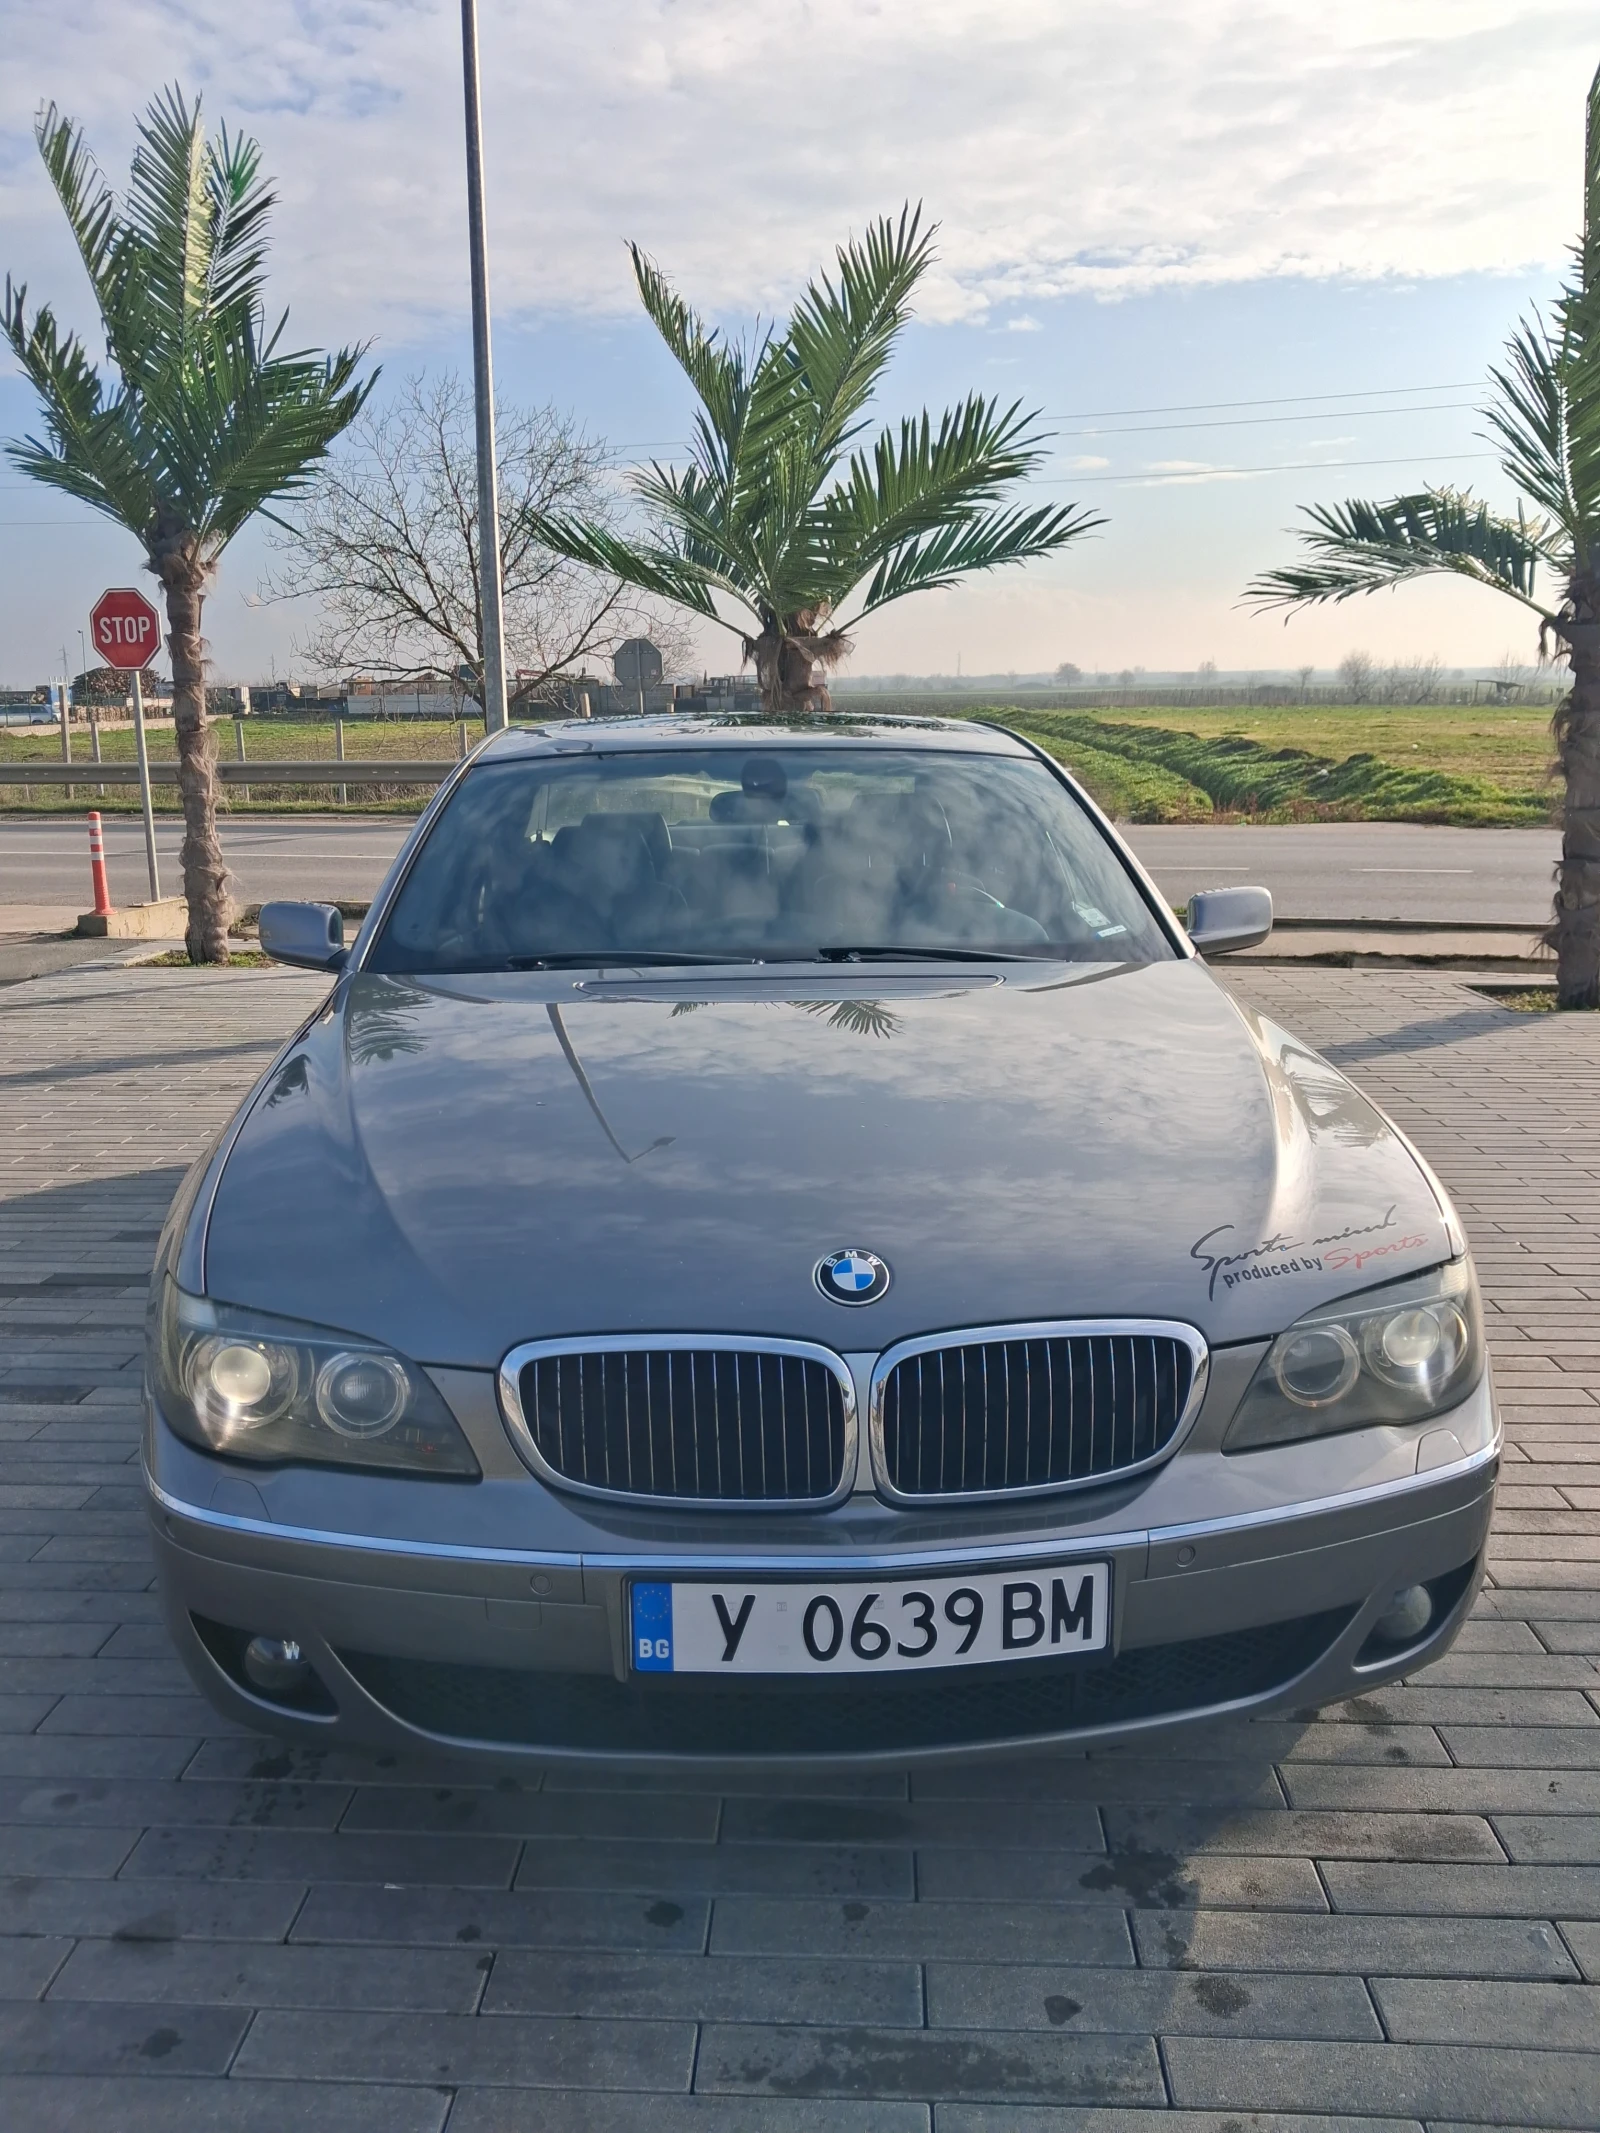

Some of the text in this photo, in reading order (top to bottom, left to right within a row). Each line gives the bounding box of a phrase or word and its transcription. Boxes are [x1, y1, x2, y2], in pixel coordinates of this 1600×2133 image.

[99, 616, 151, 644] STOP
[824, 1250, 881, 1268] BMW
[1190, 1224, 1305, 1302] Sports
[1223, 1233, 1430, 1289] produced by Sports
[802, 1587, 985, 1662] 0639
[1001, 1573, 1095, 1650] BM
[638, 1638, 670, 1659] BG
